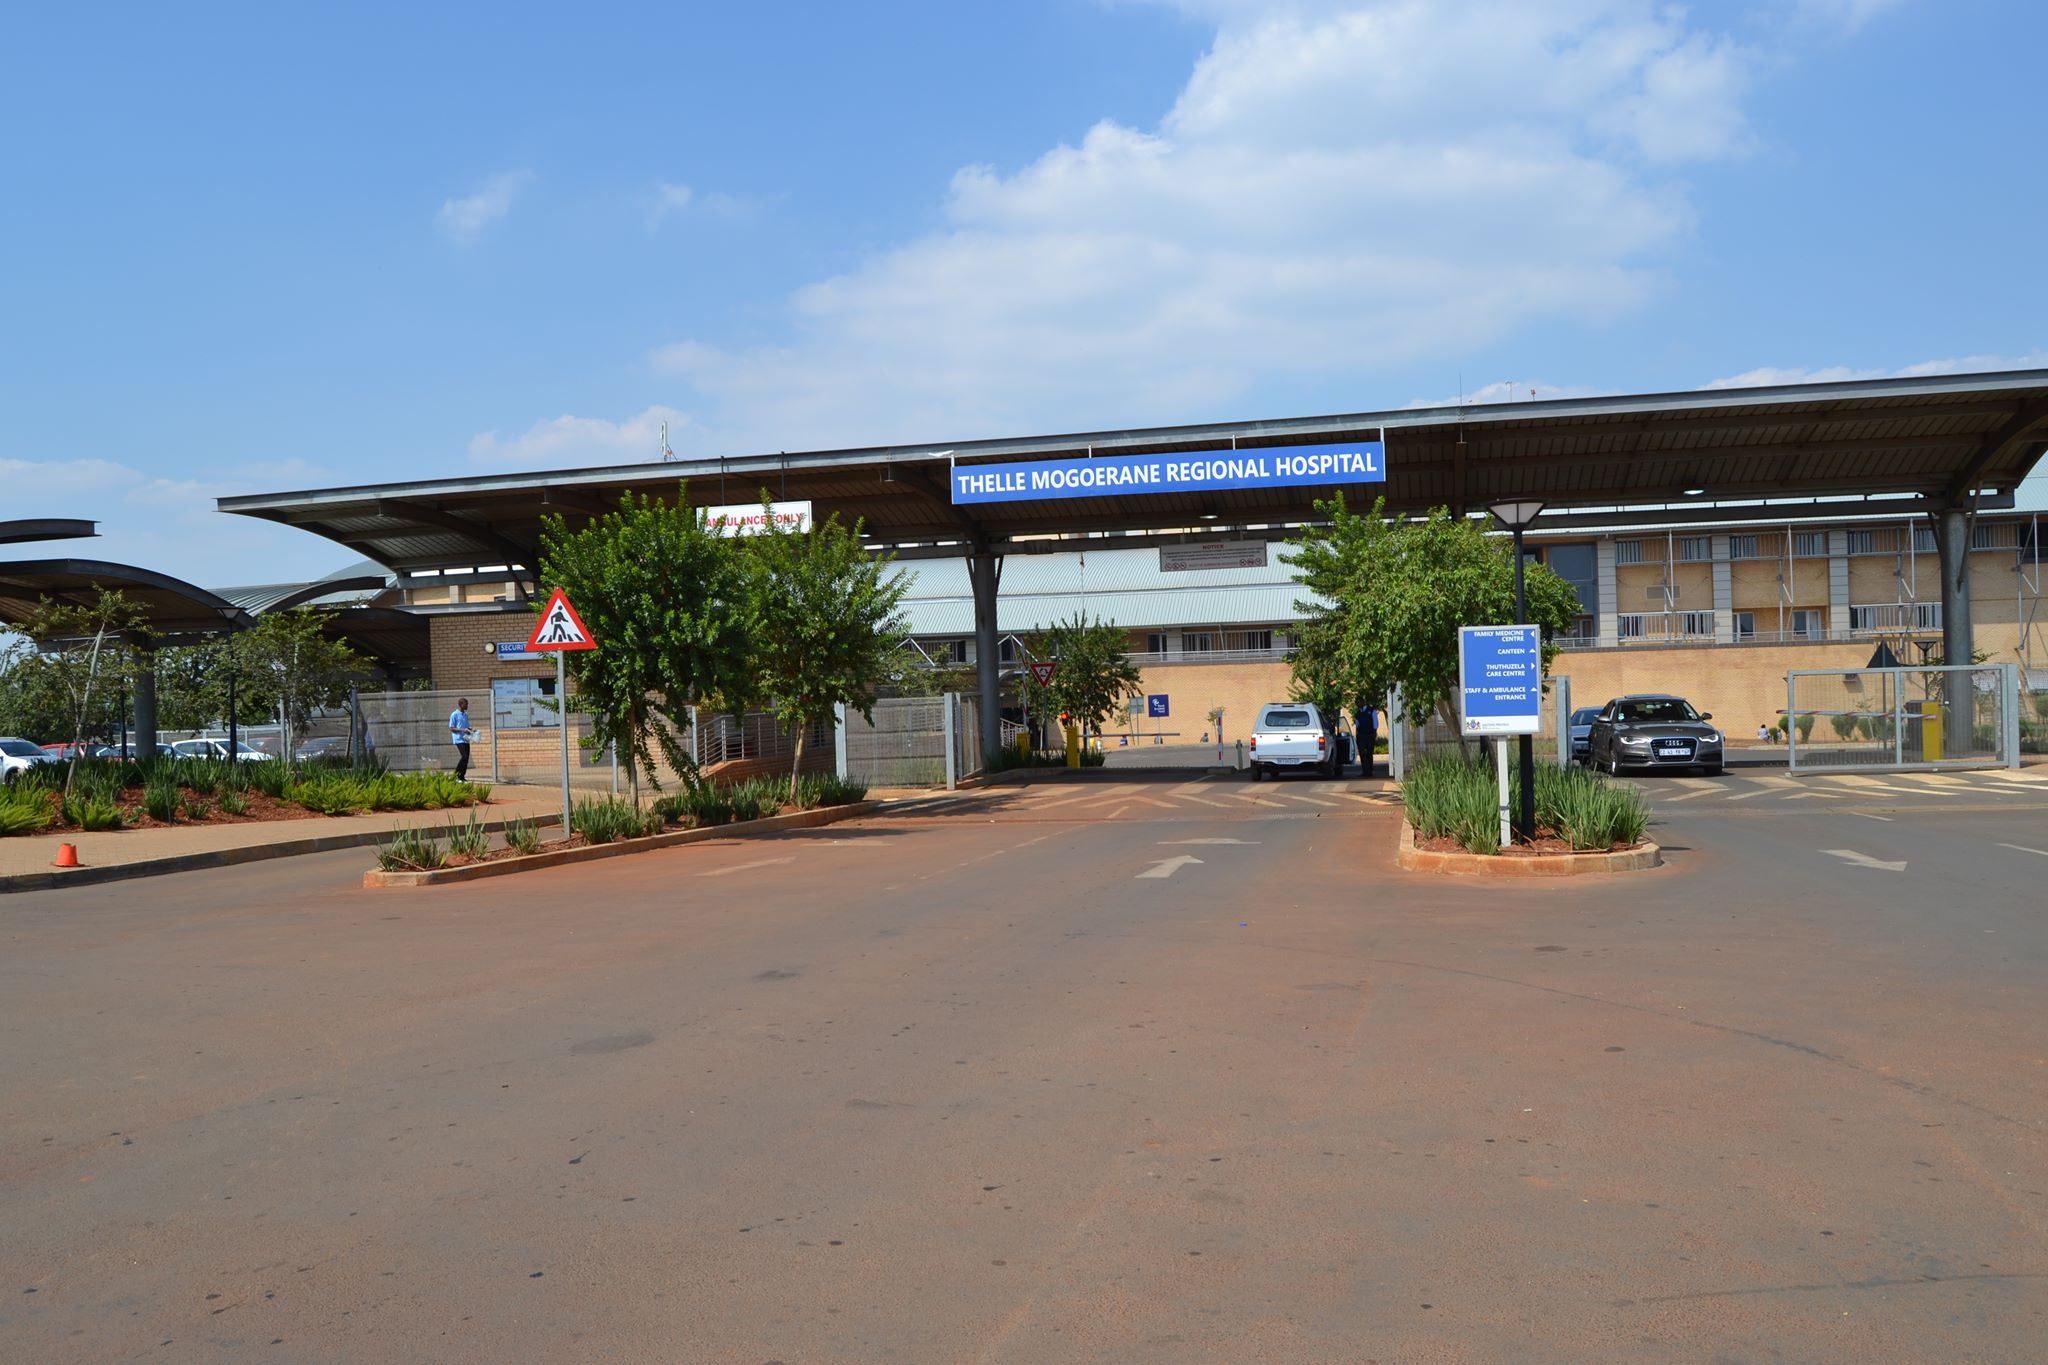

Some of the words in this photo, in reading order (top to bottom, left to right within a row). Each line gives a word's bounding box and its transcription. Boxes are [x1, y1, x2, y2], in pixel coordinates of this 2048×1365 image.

[958, 471, 1026, 494] THELLE
[1032, 463, 1161, 489] MOGOERANE
[1166, 458, 1270, 482] REGIONAL
[1276, 452, 1377, 476] HOSPITAL
